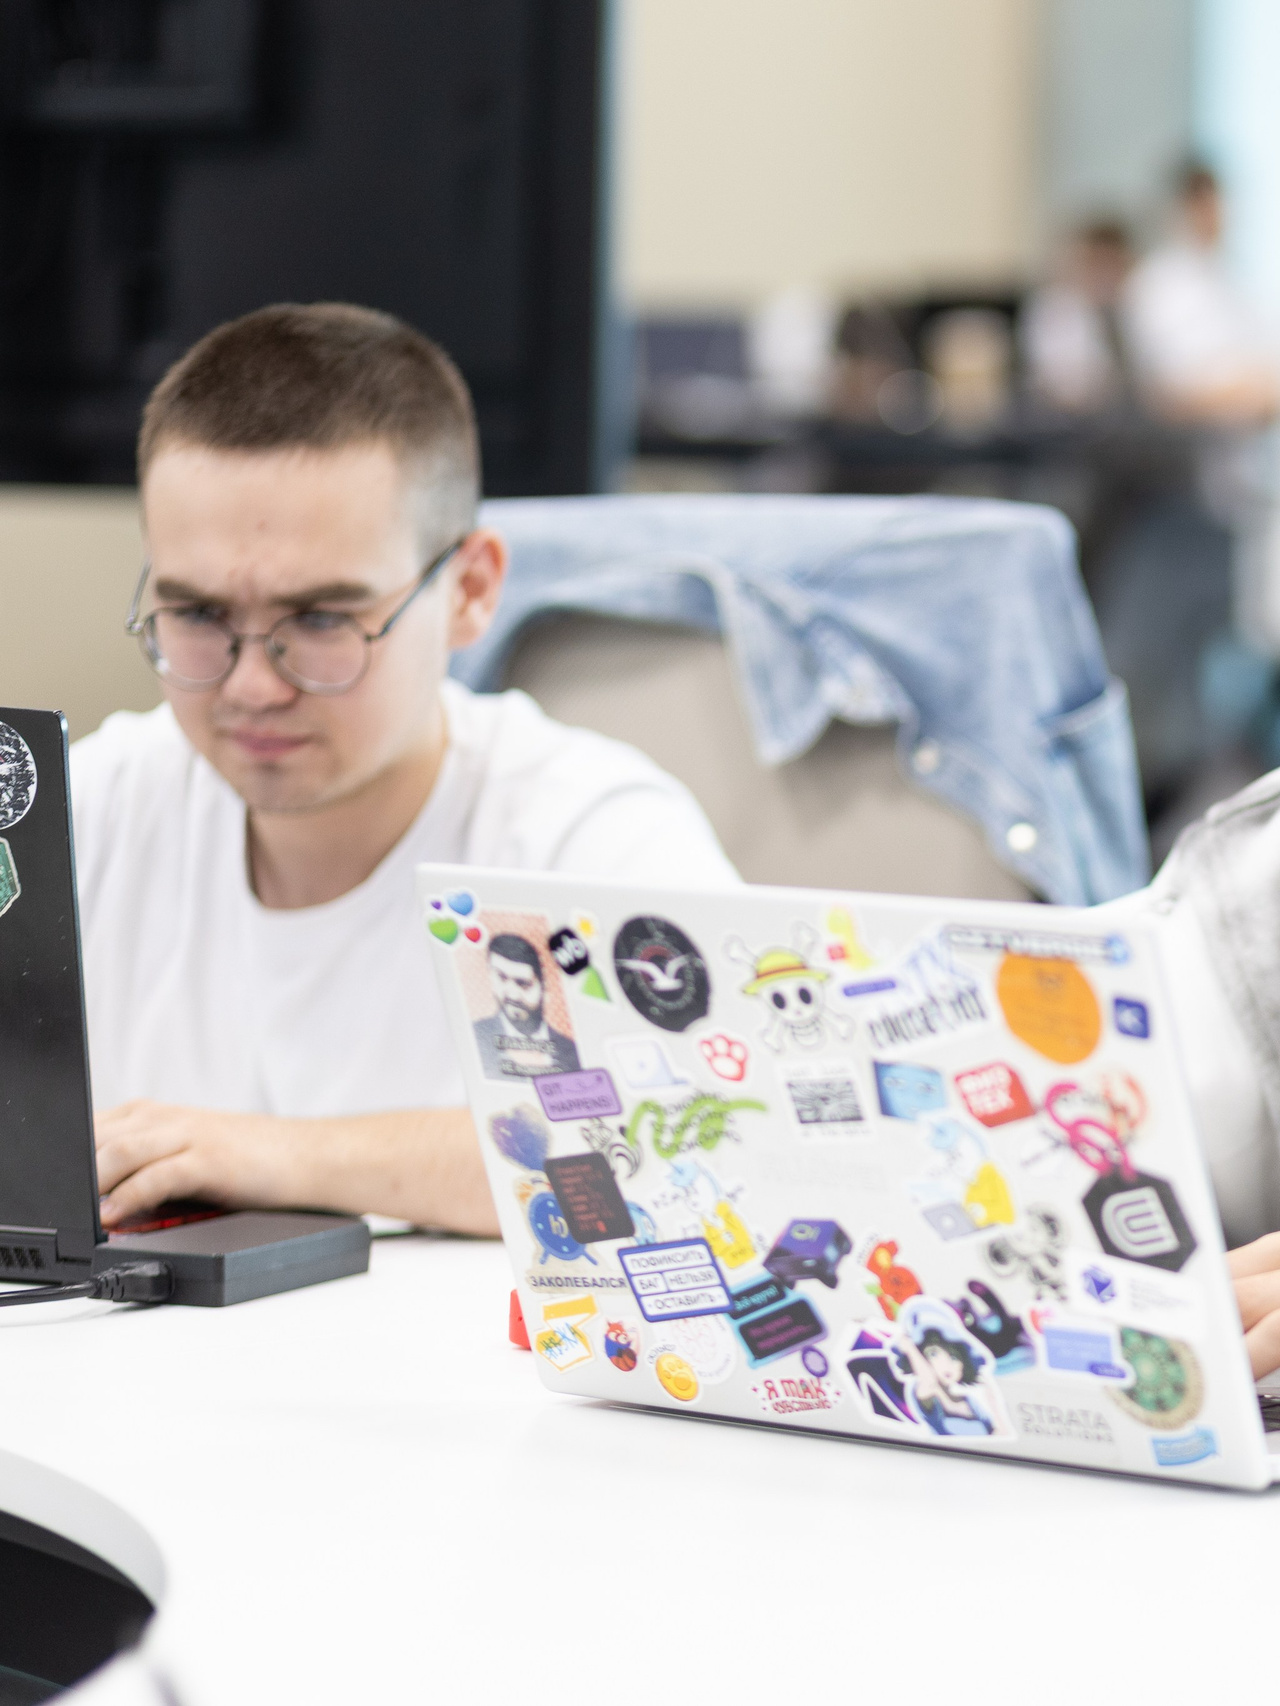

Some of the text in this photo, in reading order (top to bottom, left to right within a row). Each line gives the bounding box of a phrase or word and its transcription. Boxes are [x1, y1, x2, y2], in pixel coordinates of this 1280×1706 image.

[530, 1275, 627, 1290] ЗАКОЛЕБАЛСЯ
[639, 1269, 717, 1291] БАГ НЕЛЬЗЯ
[764, 1380, 779, 1401] Я
[1016, 1402, 1112, 1431] STRATA
